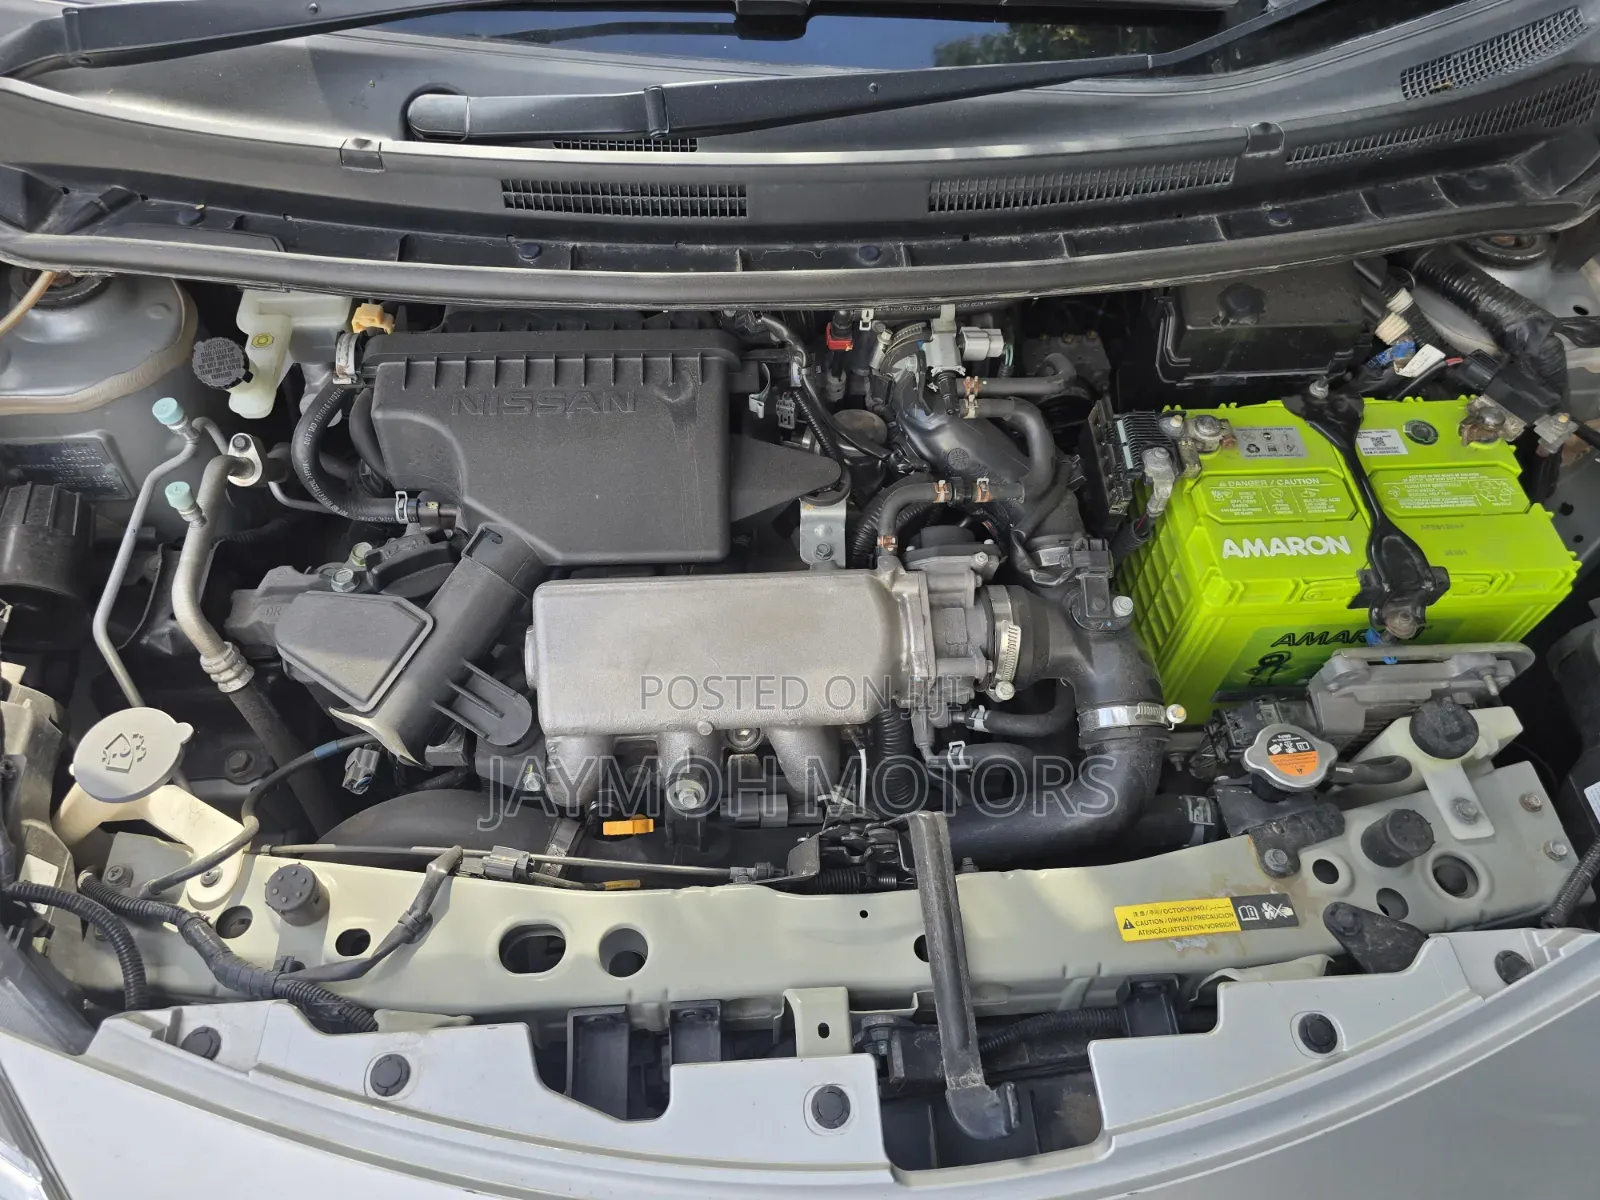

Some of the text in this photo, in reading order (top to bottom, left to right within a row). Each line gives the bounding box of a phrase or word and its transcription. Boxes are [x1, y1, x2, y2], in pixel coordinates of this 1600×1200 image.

[451, 390, 636, 416] NISSAN
[1276, 477, 1320, 486] CAUTION
[1222, 535, 1352, 559] AMARON
[1135, 918, 1164, 927] CAUTION
